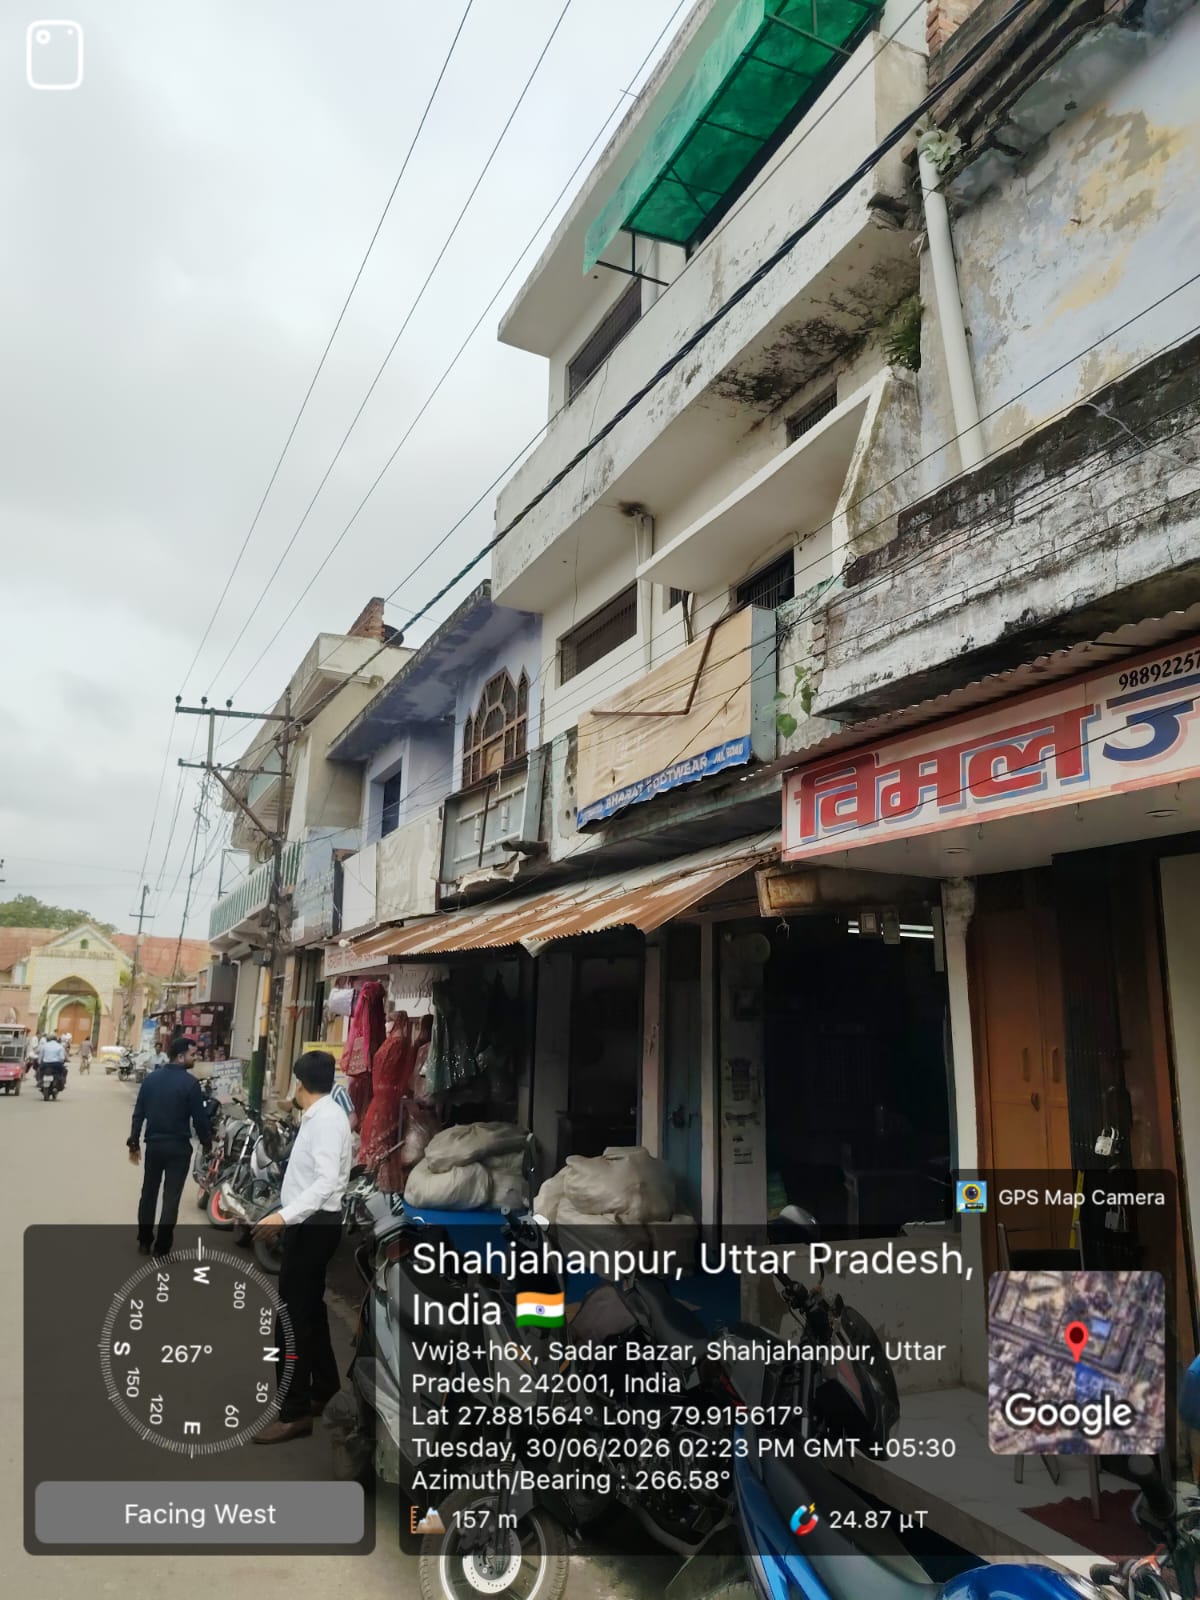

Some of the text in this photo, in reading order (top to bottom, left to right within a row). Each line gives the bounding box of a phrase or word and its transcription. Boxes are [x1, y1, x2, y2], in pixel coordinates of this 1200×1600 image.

[1118, 650, 1200, 691] 98892257
[605, 783, 643, 808] BHARAT
[645, 756, 708, 792] FOOTWEAR
[794, 704, 1100, 842] विमल
